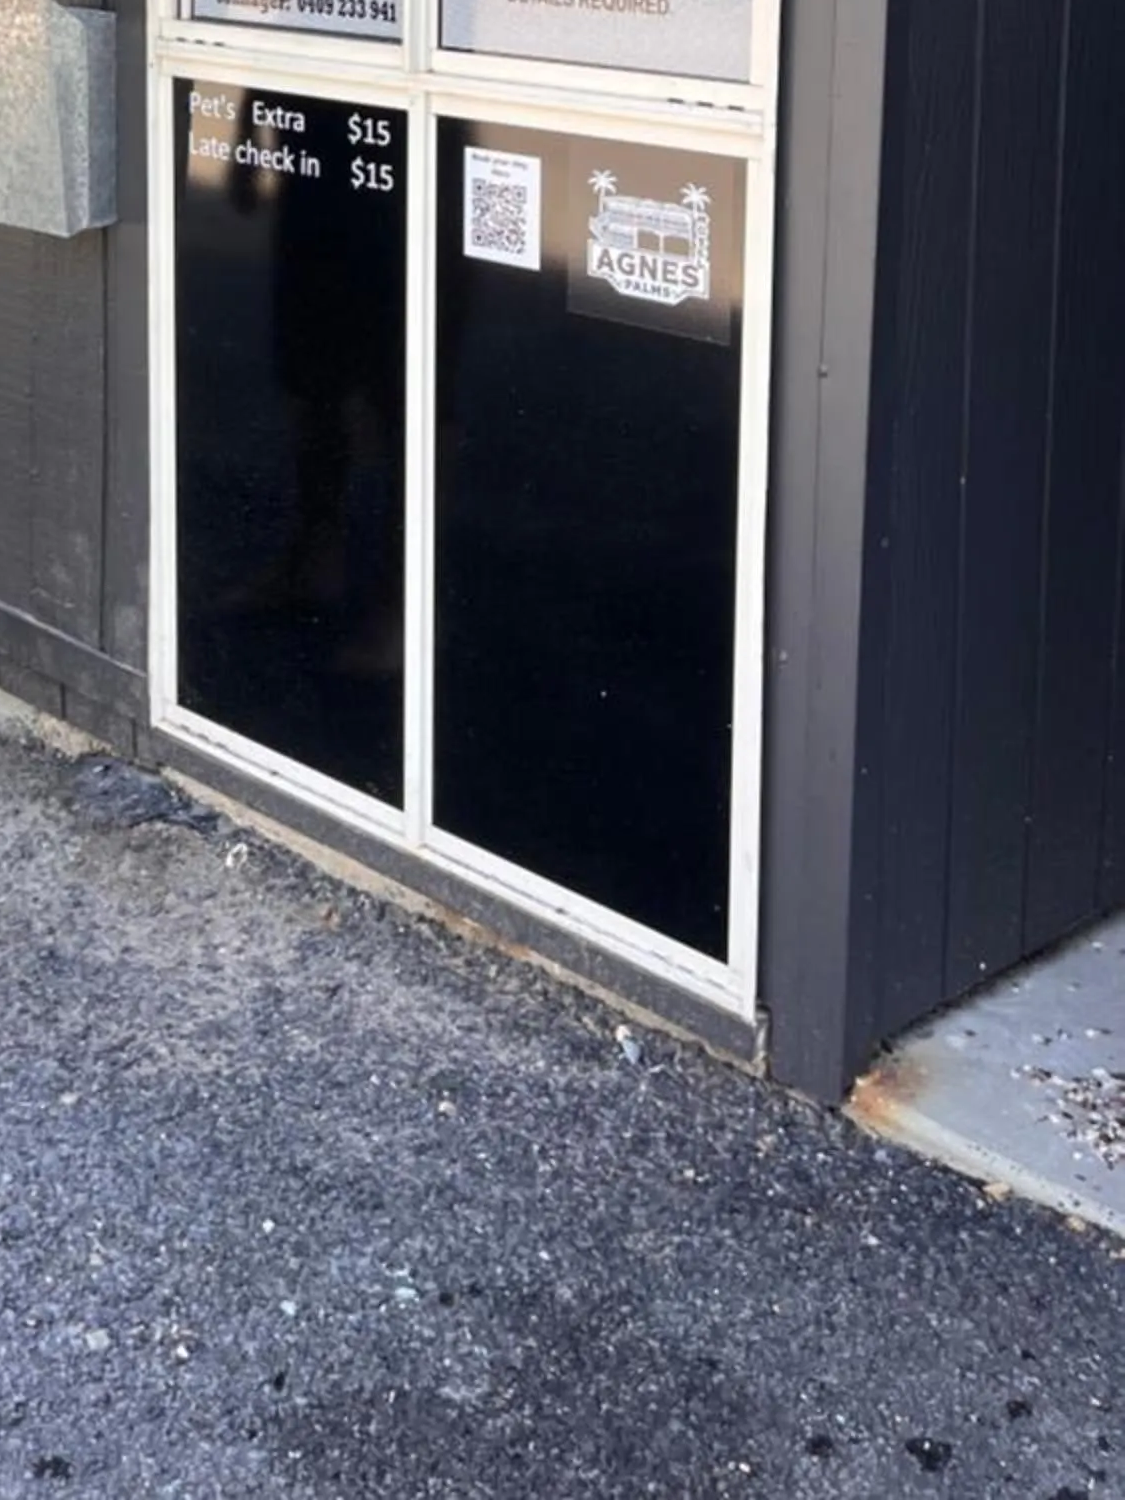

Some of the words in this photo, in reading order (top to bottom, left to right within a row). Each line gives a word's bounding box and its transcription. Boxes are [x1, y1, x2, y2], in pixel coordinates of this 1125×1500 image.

[370, 0, 397, 23] 941
[188, 91, 236, 120] Pet's
[252, 100, 305, 132] Extra
[347, 112, 391, 146] $15
[188, 132, 230, 161] Late
[235, 140, 295, 174] check
[299, 150, 321, 178] in
[351, 156, 394, 191] $15
[597, 248, 699, 288] AGNES
[624, 279, 672, 298] PALMS
